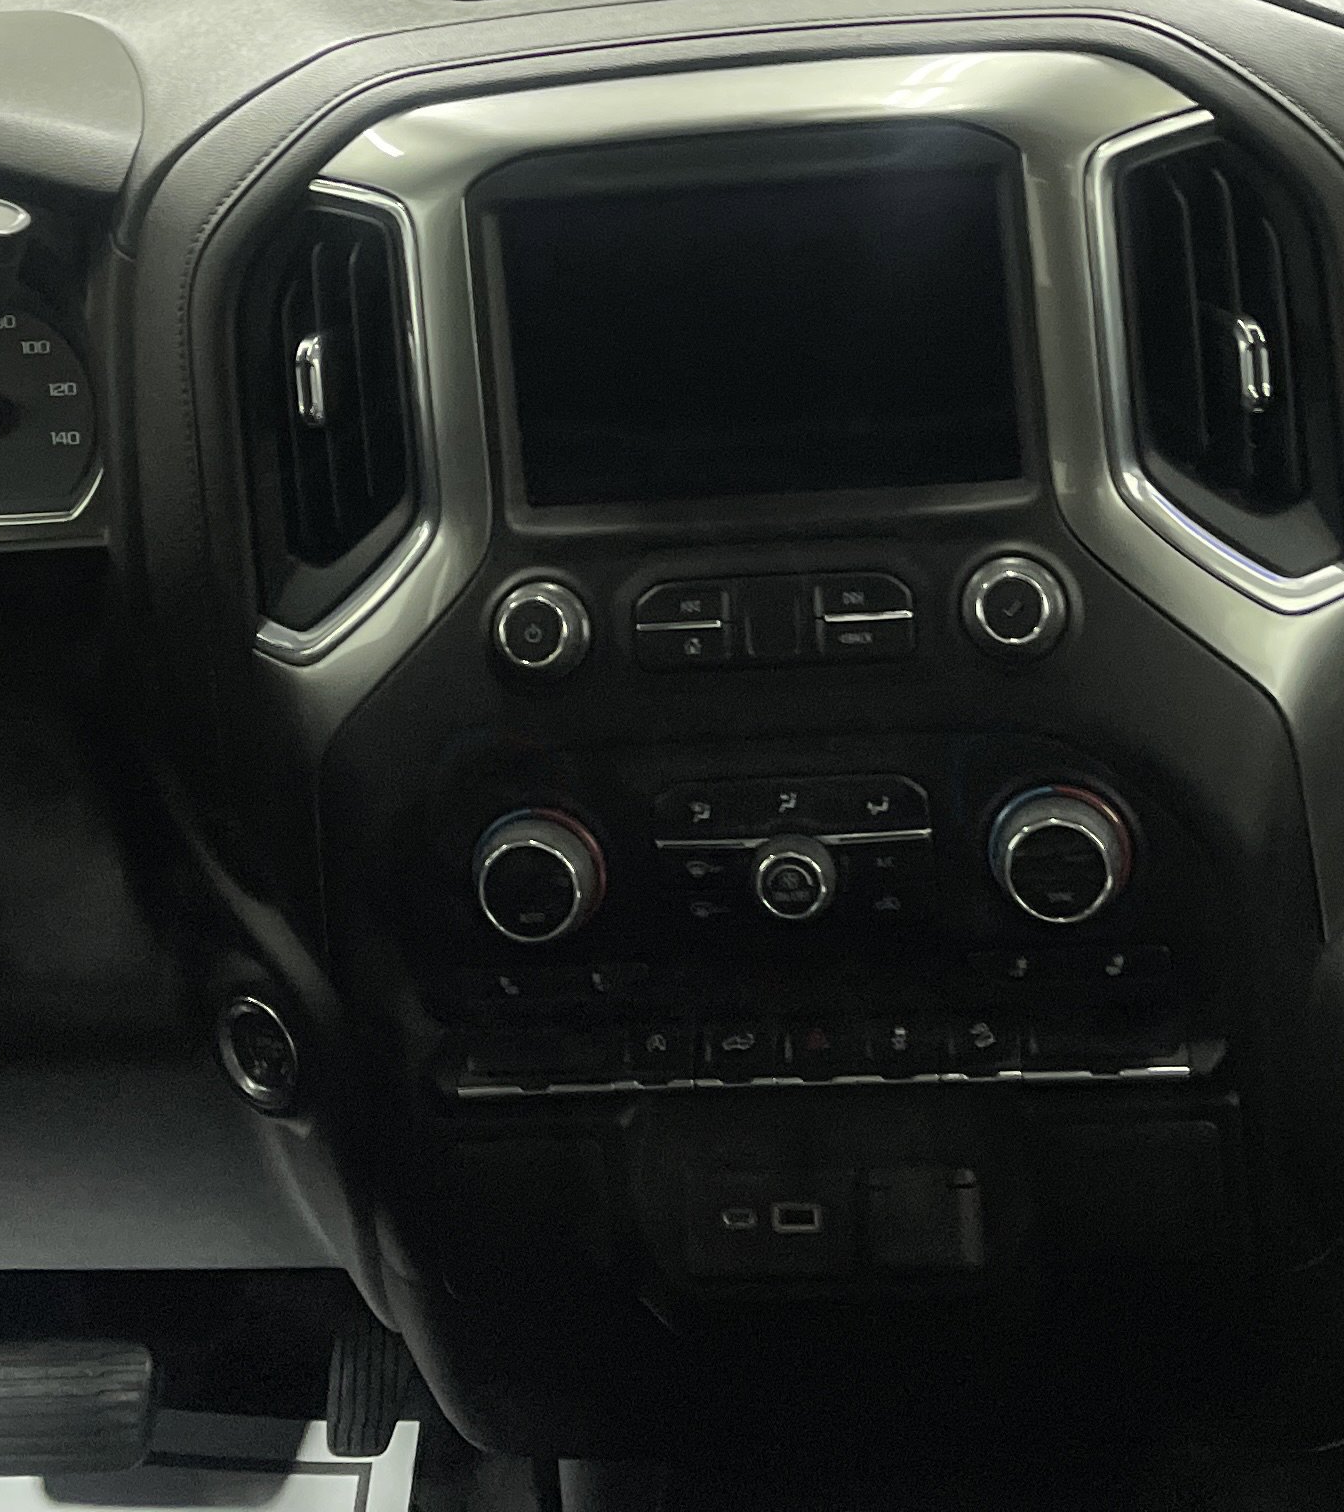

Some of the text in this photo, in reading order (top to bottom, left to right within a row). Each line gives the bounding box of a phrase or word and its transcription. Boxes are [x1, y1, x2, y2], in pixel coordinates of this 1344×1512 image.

[21, 340, 50, 355] 100
[48, 381, 77, 397] 120
[49, 431, 80, 445] 140
